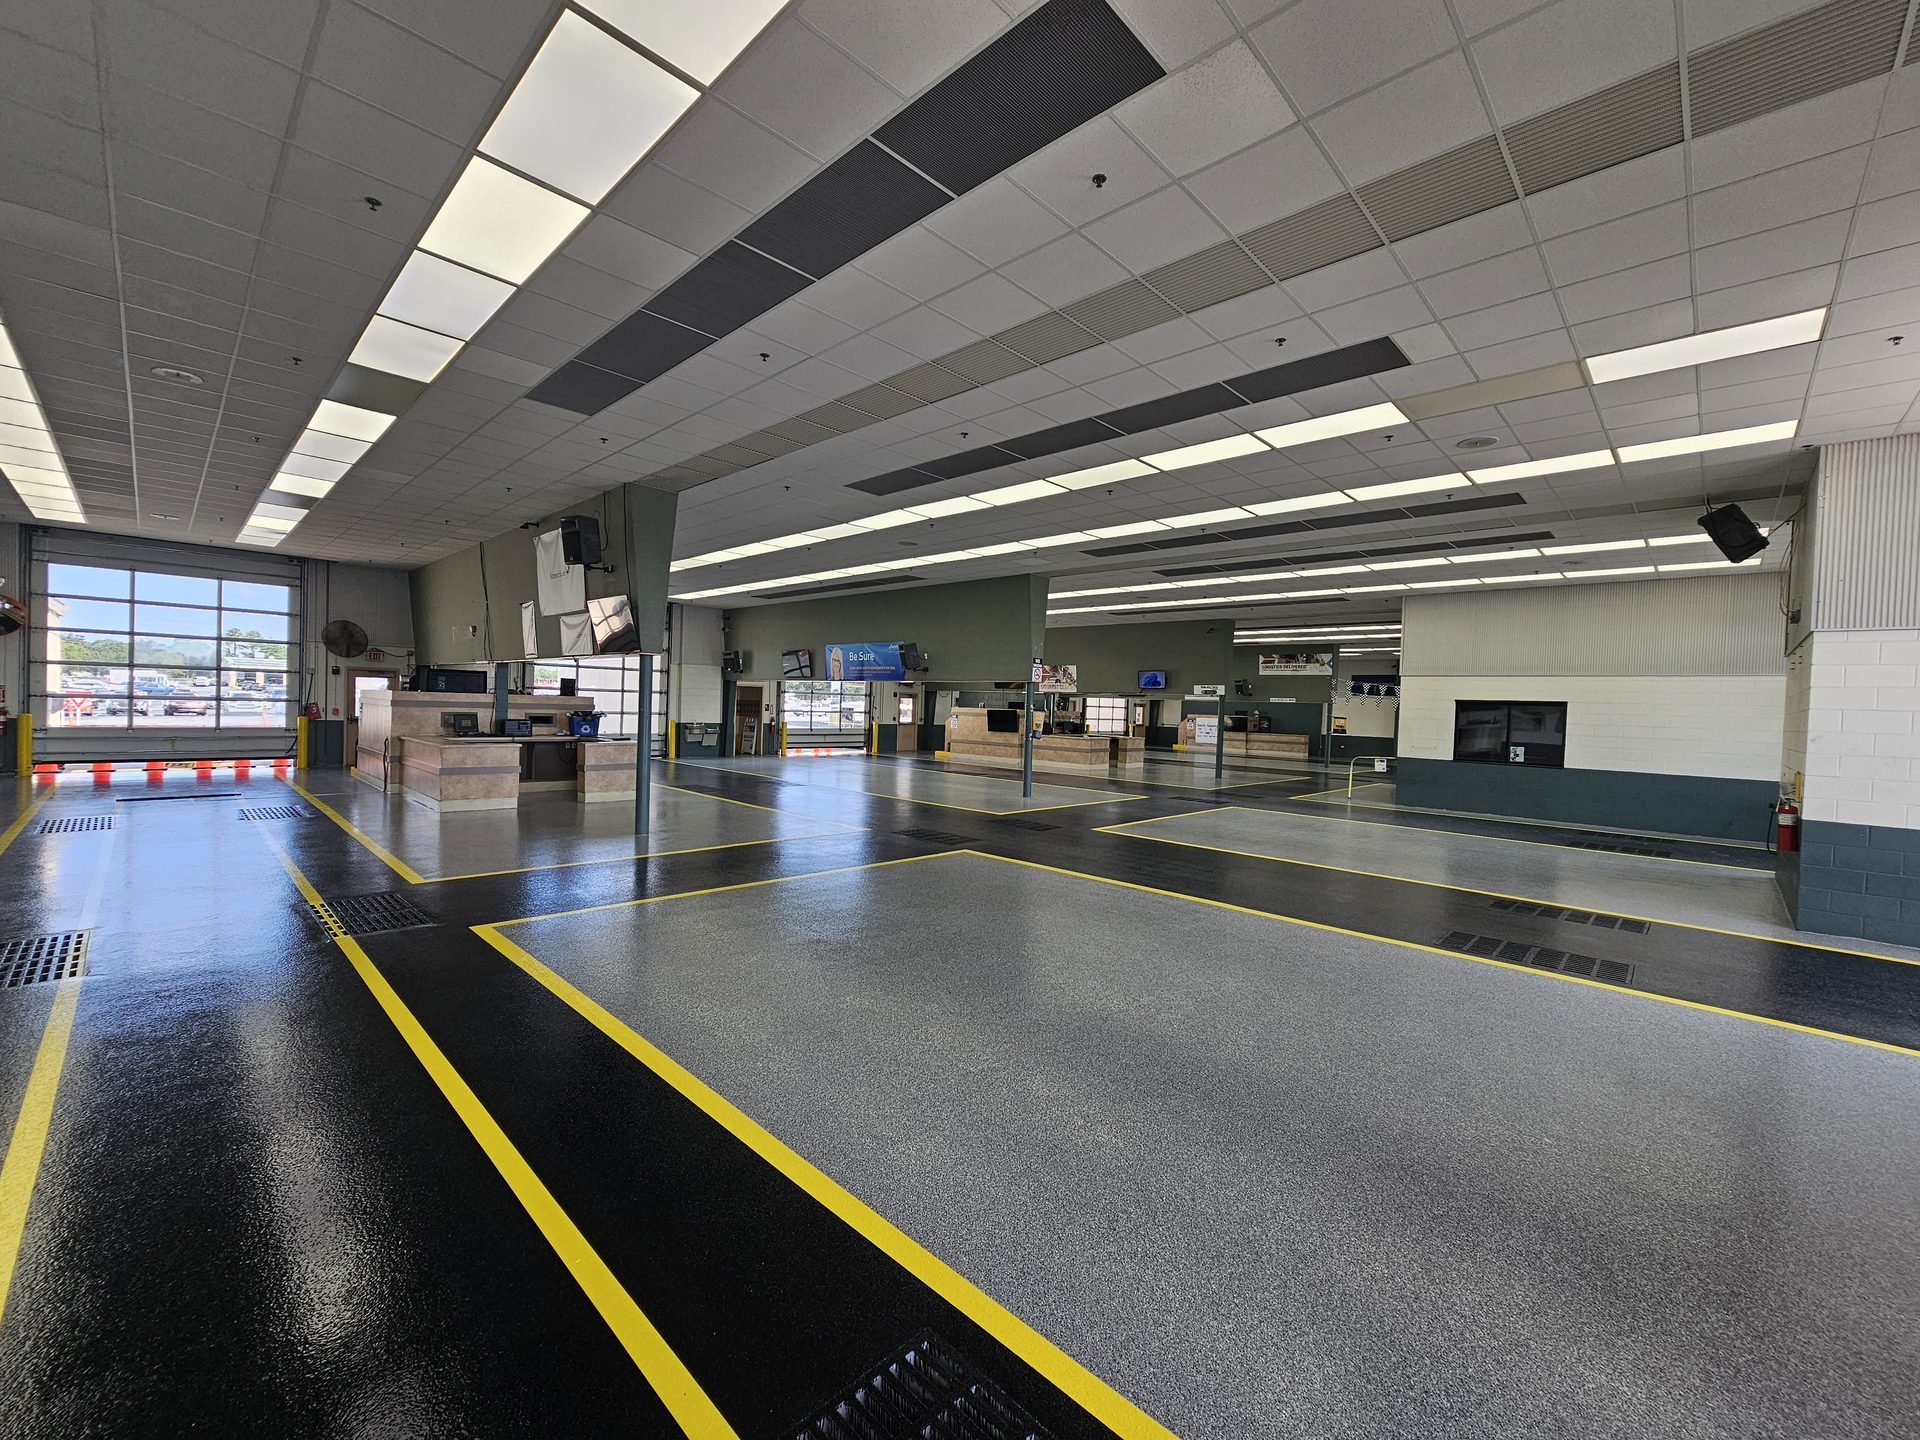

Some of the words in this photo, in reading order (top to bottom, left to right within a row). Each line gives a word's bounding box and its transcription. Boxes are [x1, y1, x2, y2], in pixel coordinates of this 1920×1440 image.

[369, 652, 381, 660] EXIT
[849, 651, 857, 661] Be
[858, 651, 875, 661] Sure
